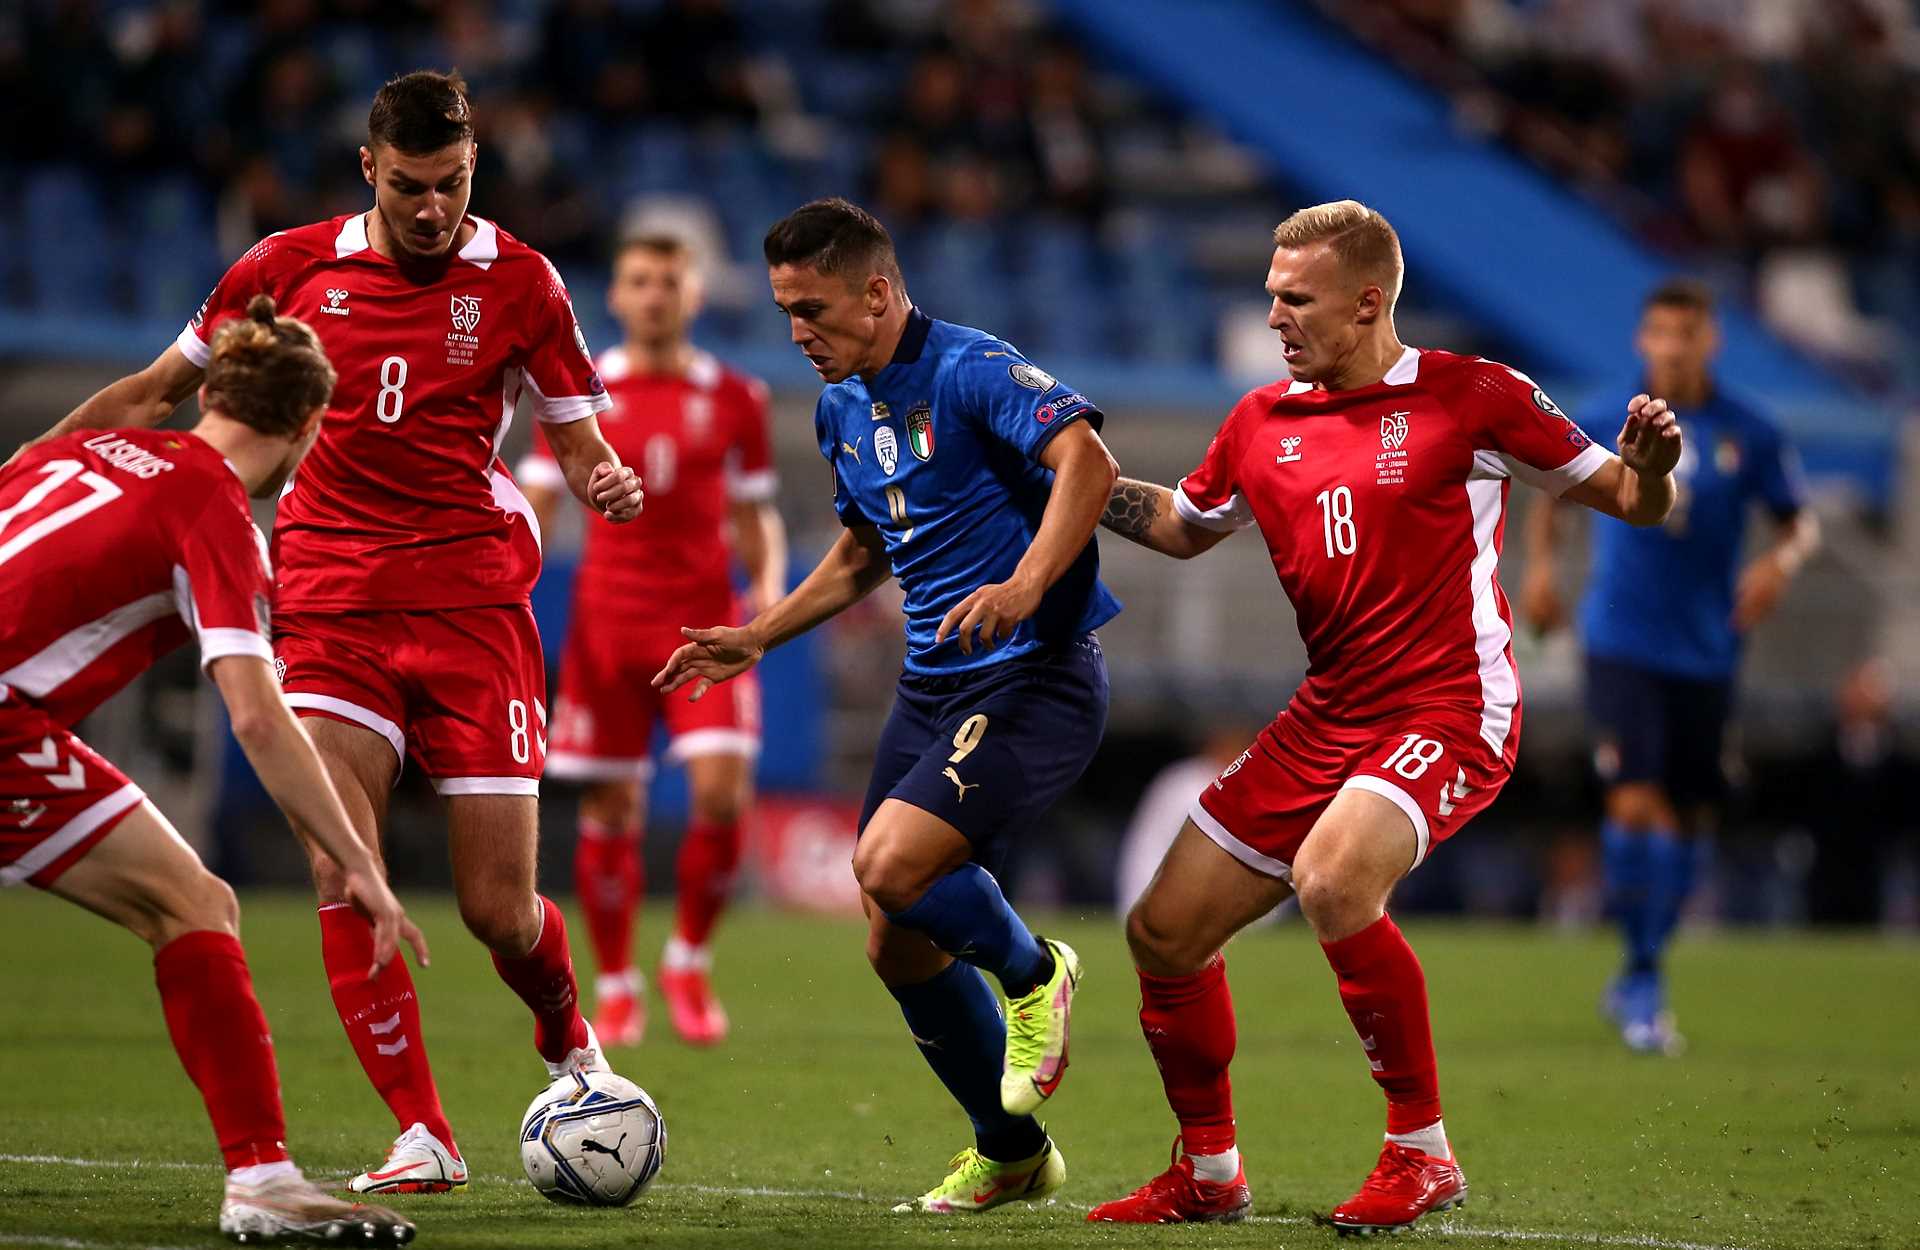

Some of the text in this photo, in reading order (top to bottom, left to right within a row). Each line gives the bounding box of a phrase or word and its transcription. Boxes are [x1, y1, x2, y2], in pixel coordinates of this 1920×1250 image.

[320, 304, 350, 316] hummel
[447, 332, 479, 343] LIETUVA
[376, 355, 408, 424] 8
[1376, 450, 1408, 460] LIETUVA
[0, 459, 124, 566] 17
[1316, 485, 1358, 559] 18
[508, 699, 530, 764] 8
[947, 713, 989, 764] 9
[1380, 733, 1445, 780] 18
